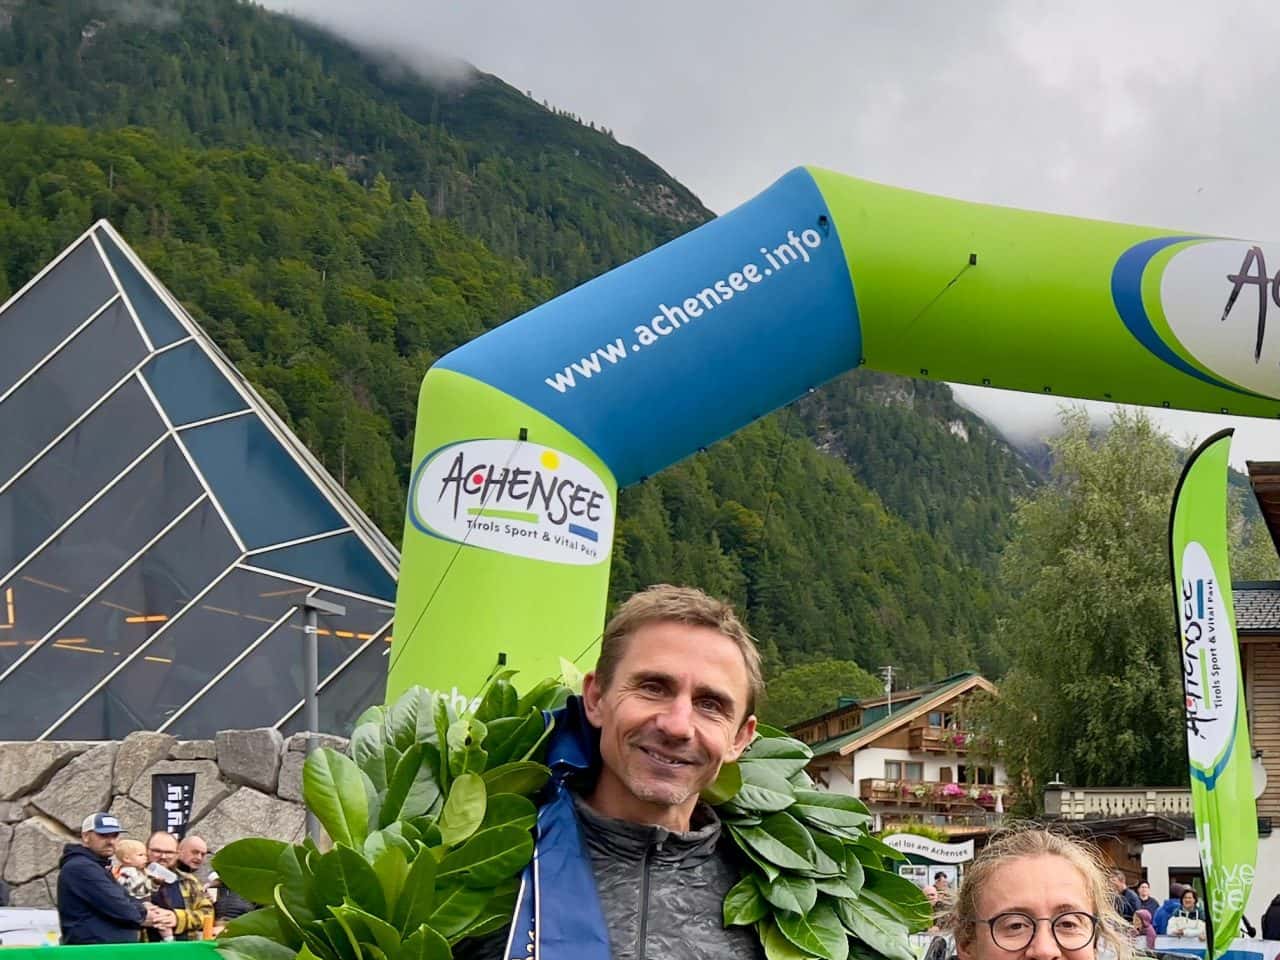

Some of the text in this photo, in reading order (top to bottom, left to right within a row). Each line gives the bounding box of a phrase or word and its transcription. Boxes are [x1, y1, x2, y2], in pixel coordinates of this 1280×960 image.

[544, 227, 822, 394] www.achensee.info
[436, 452, 604, 525] ACHENSEE
[467, 518, 501, 533] Tirols
[504, 524, 538, 541] Sport
[542, 531, 551, 543] &
[554, 534, 579, 552] Vital
[1211, 647, 1222, 676] Sport
[1213, 677, 1224, 709] Tirols
